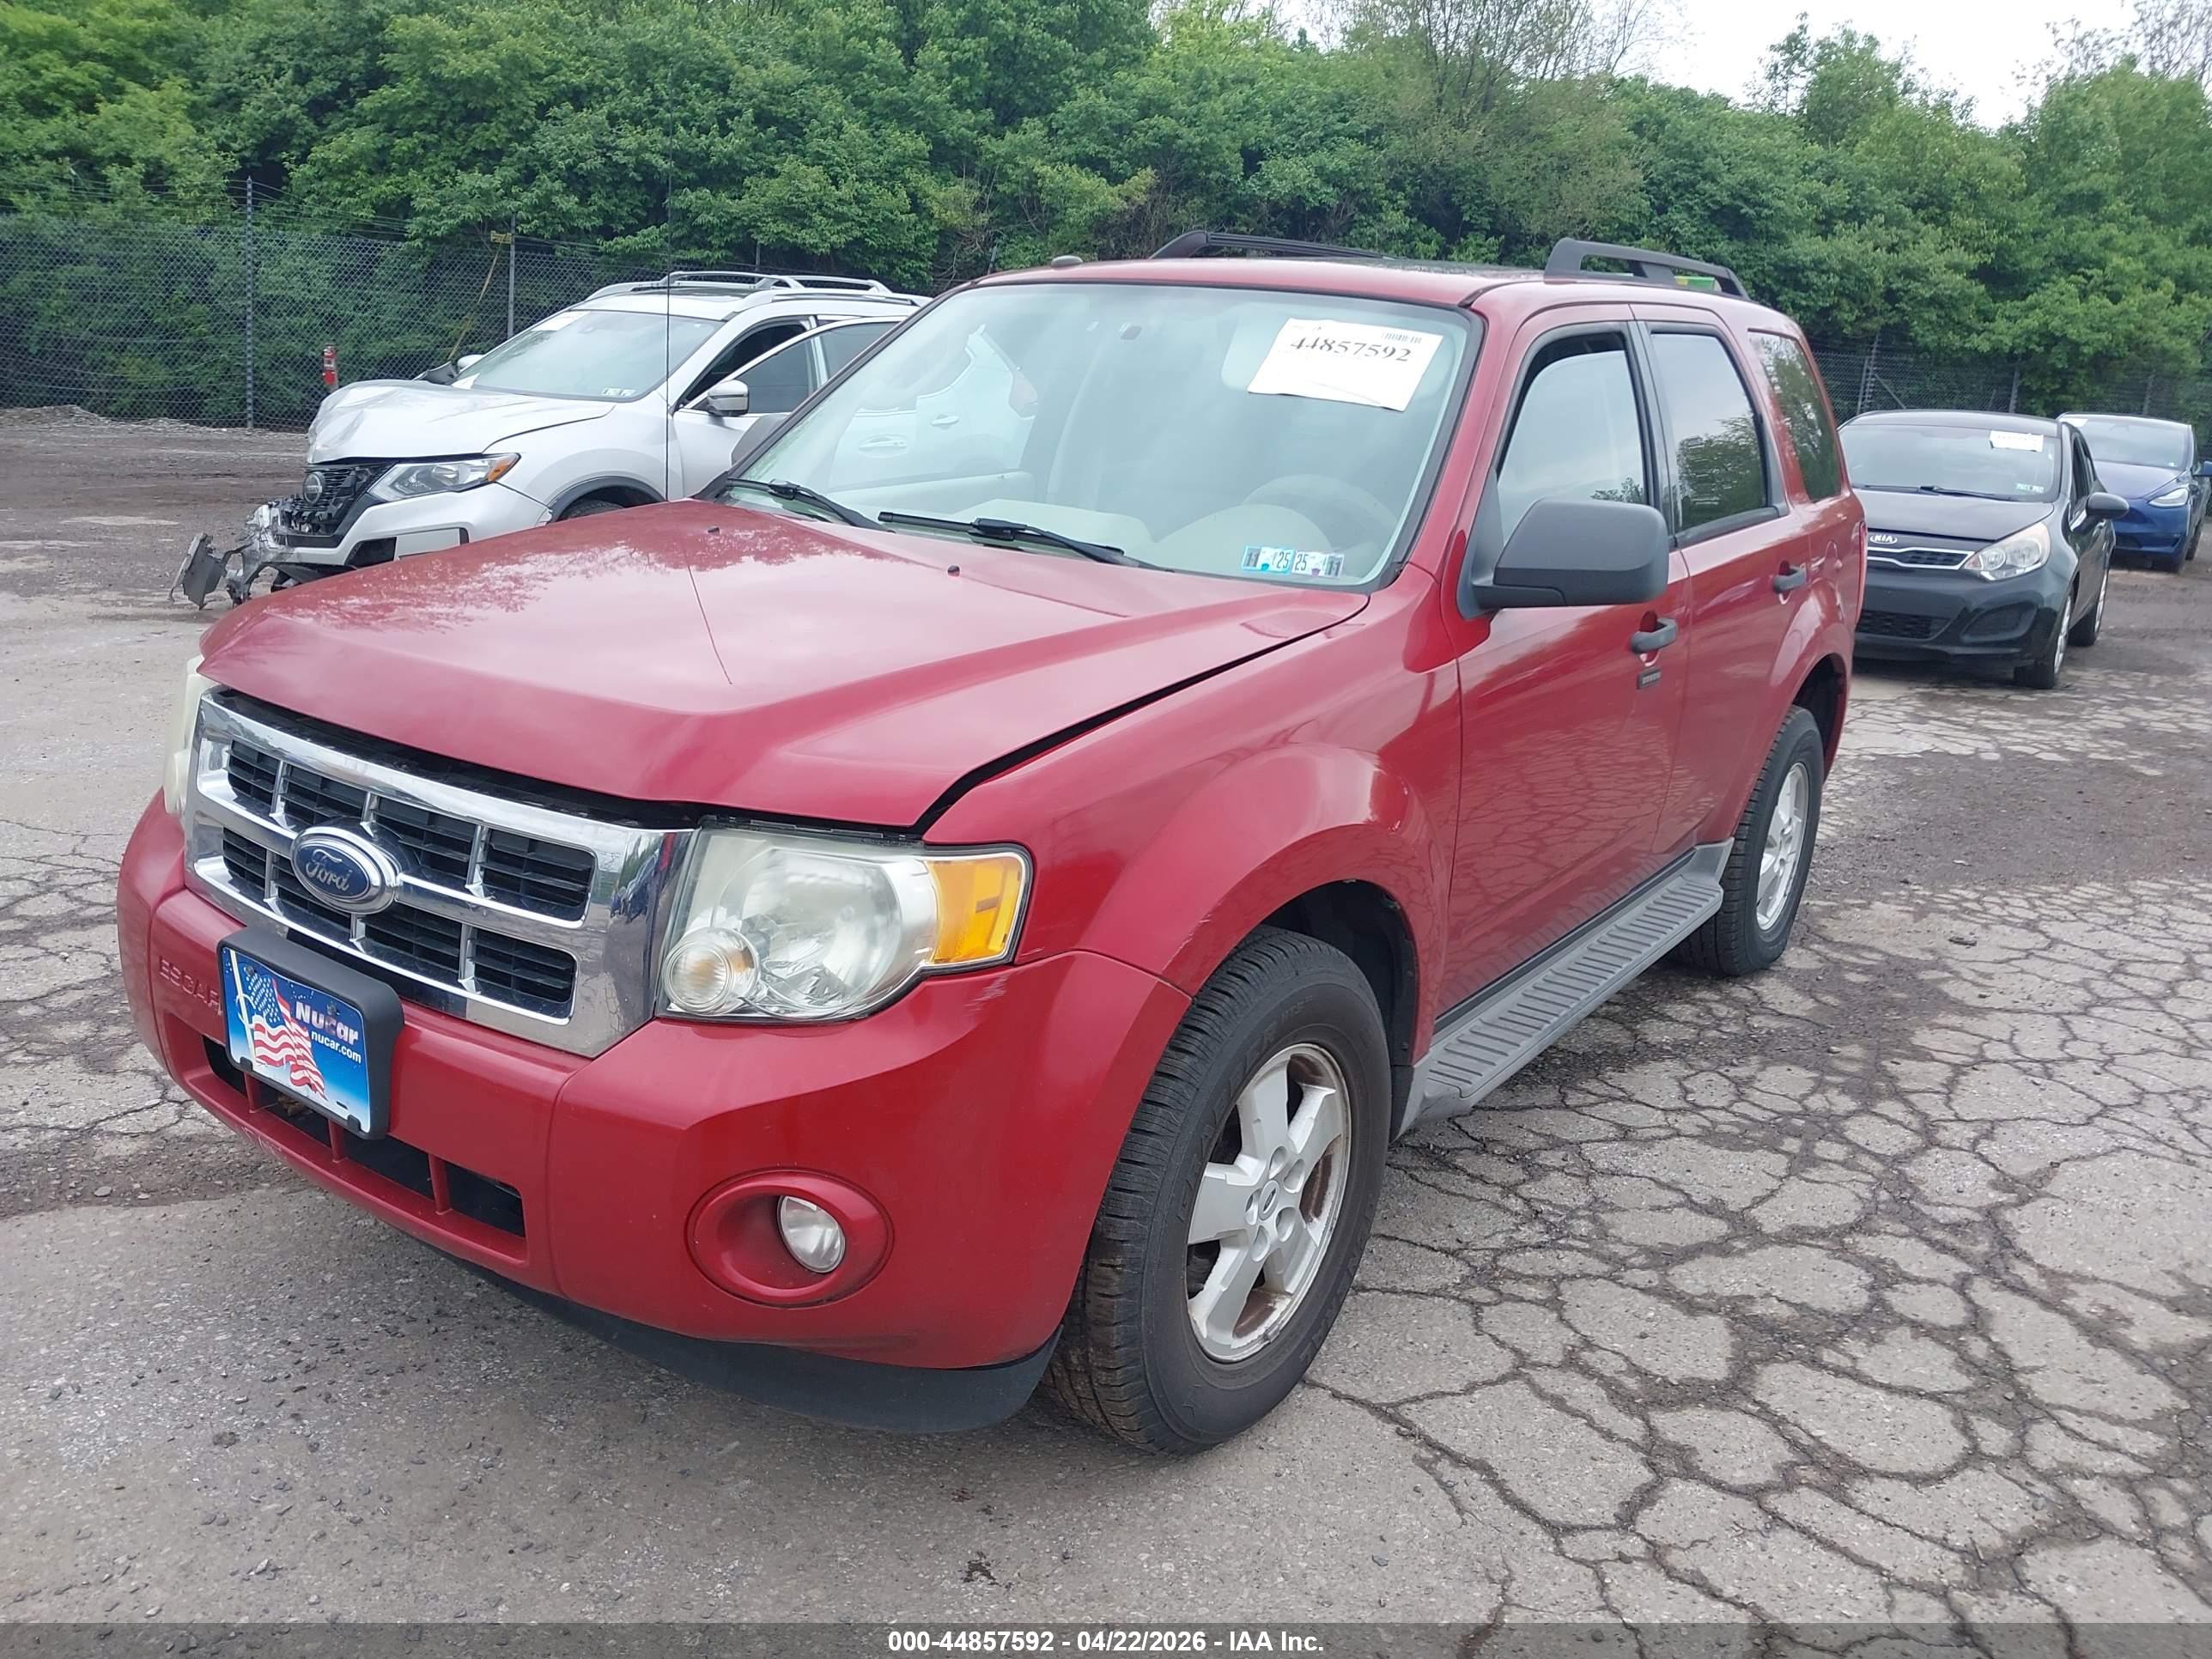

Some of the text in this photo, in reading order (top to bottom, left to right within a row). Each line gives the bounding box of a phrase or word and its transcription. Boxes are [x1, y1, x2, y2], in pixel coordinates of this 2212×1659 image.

[1291, 337, 1412, 362] 44857592
[1875, 534, 1893, 543] KIA
[1277, 551, 1291, 568] 25
[1295, 554, 1309, 571] 25
[306, 848, 352, 892] Ford
[159, 956, 221, 1015] ESCAP
[311, 1030, 362, 1064] nucar.com
